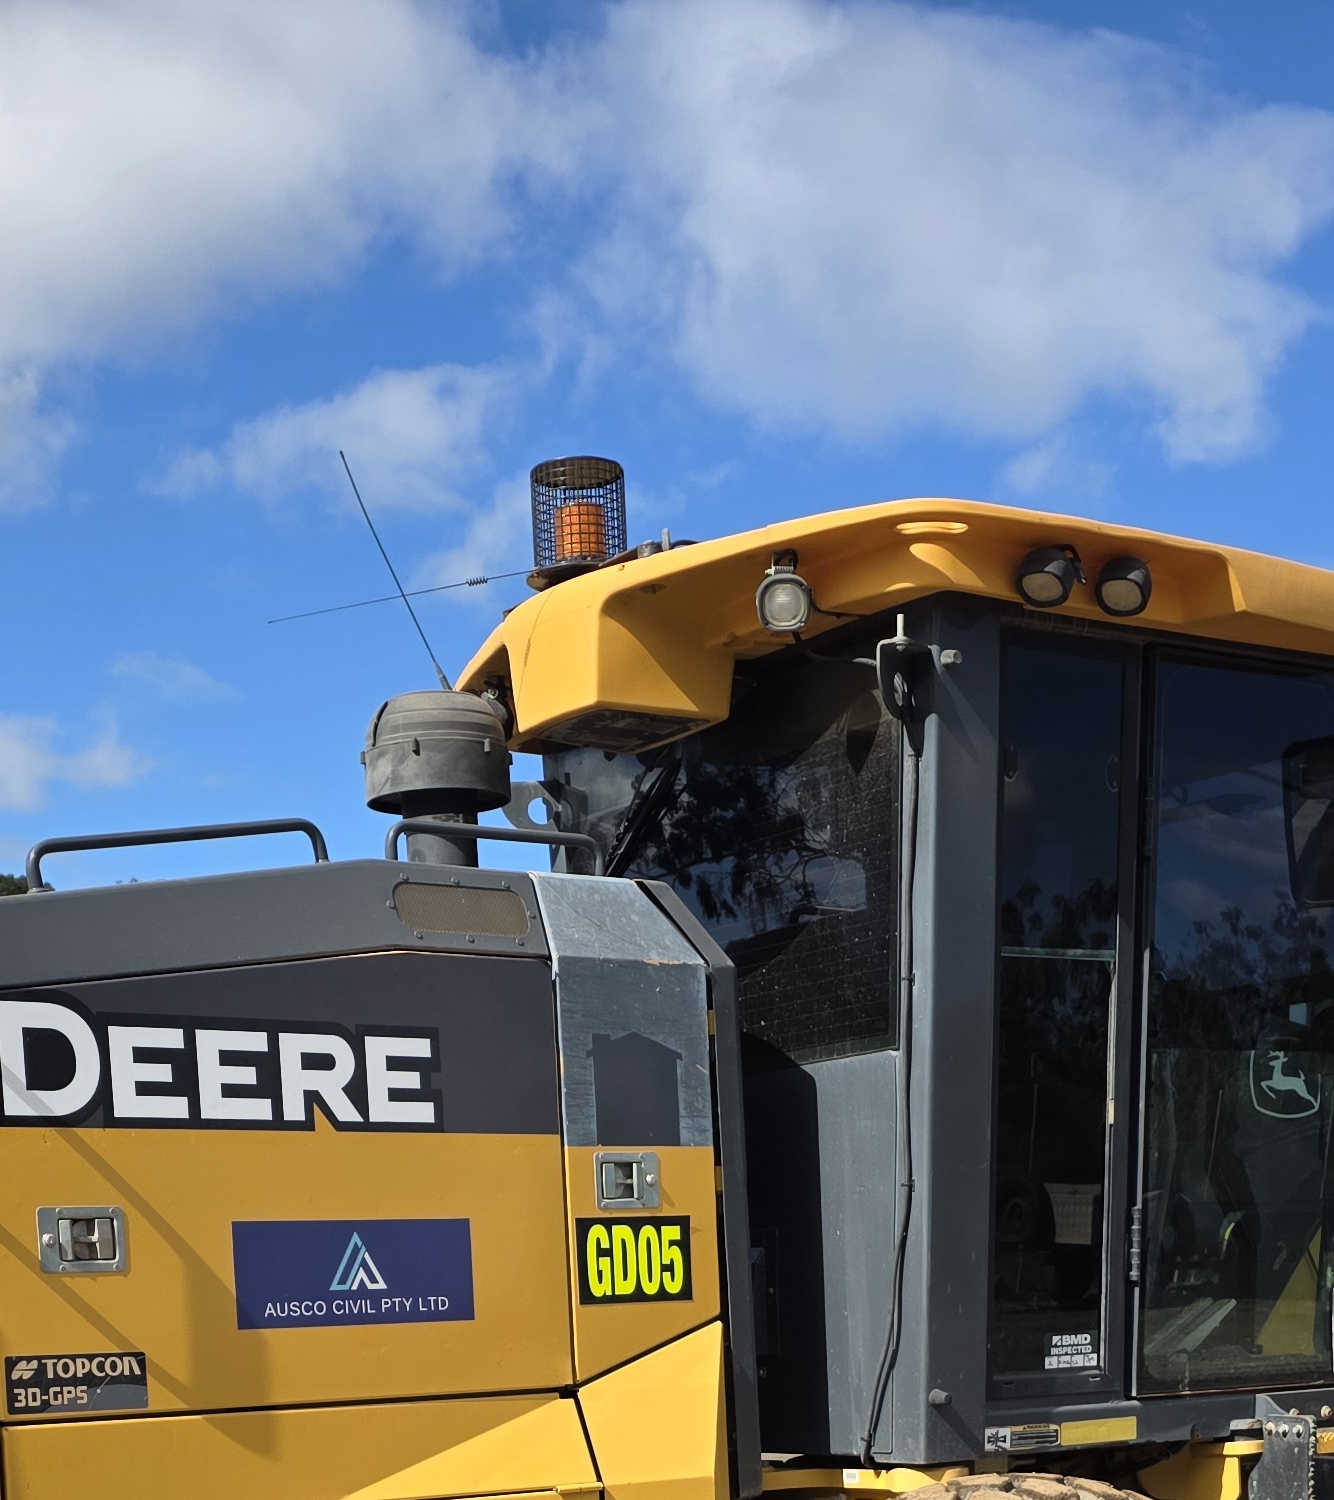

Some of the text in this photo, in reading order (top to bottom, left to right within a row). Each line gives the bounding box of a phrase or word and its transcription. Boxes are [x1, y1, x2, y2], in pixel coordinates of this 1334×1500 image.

[586, 1224, 684, 1298] GD05
[264, 1296, 449, 1317] AUSCO CIVIL PTY LTD
[1050, 1344, 1093, 1355] INSPECTED
[1062, 1333, 1091, 1345] BMD
[41, 1356, 142, 1379] TOPCON
[13, 1385, 88, 1408] 3D-GPS
